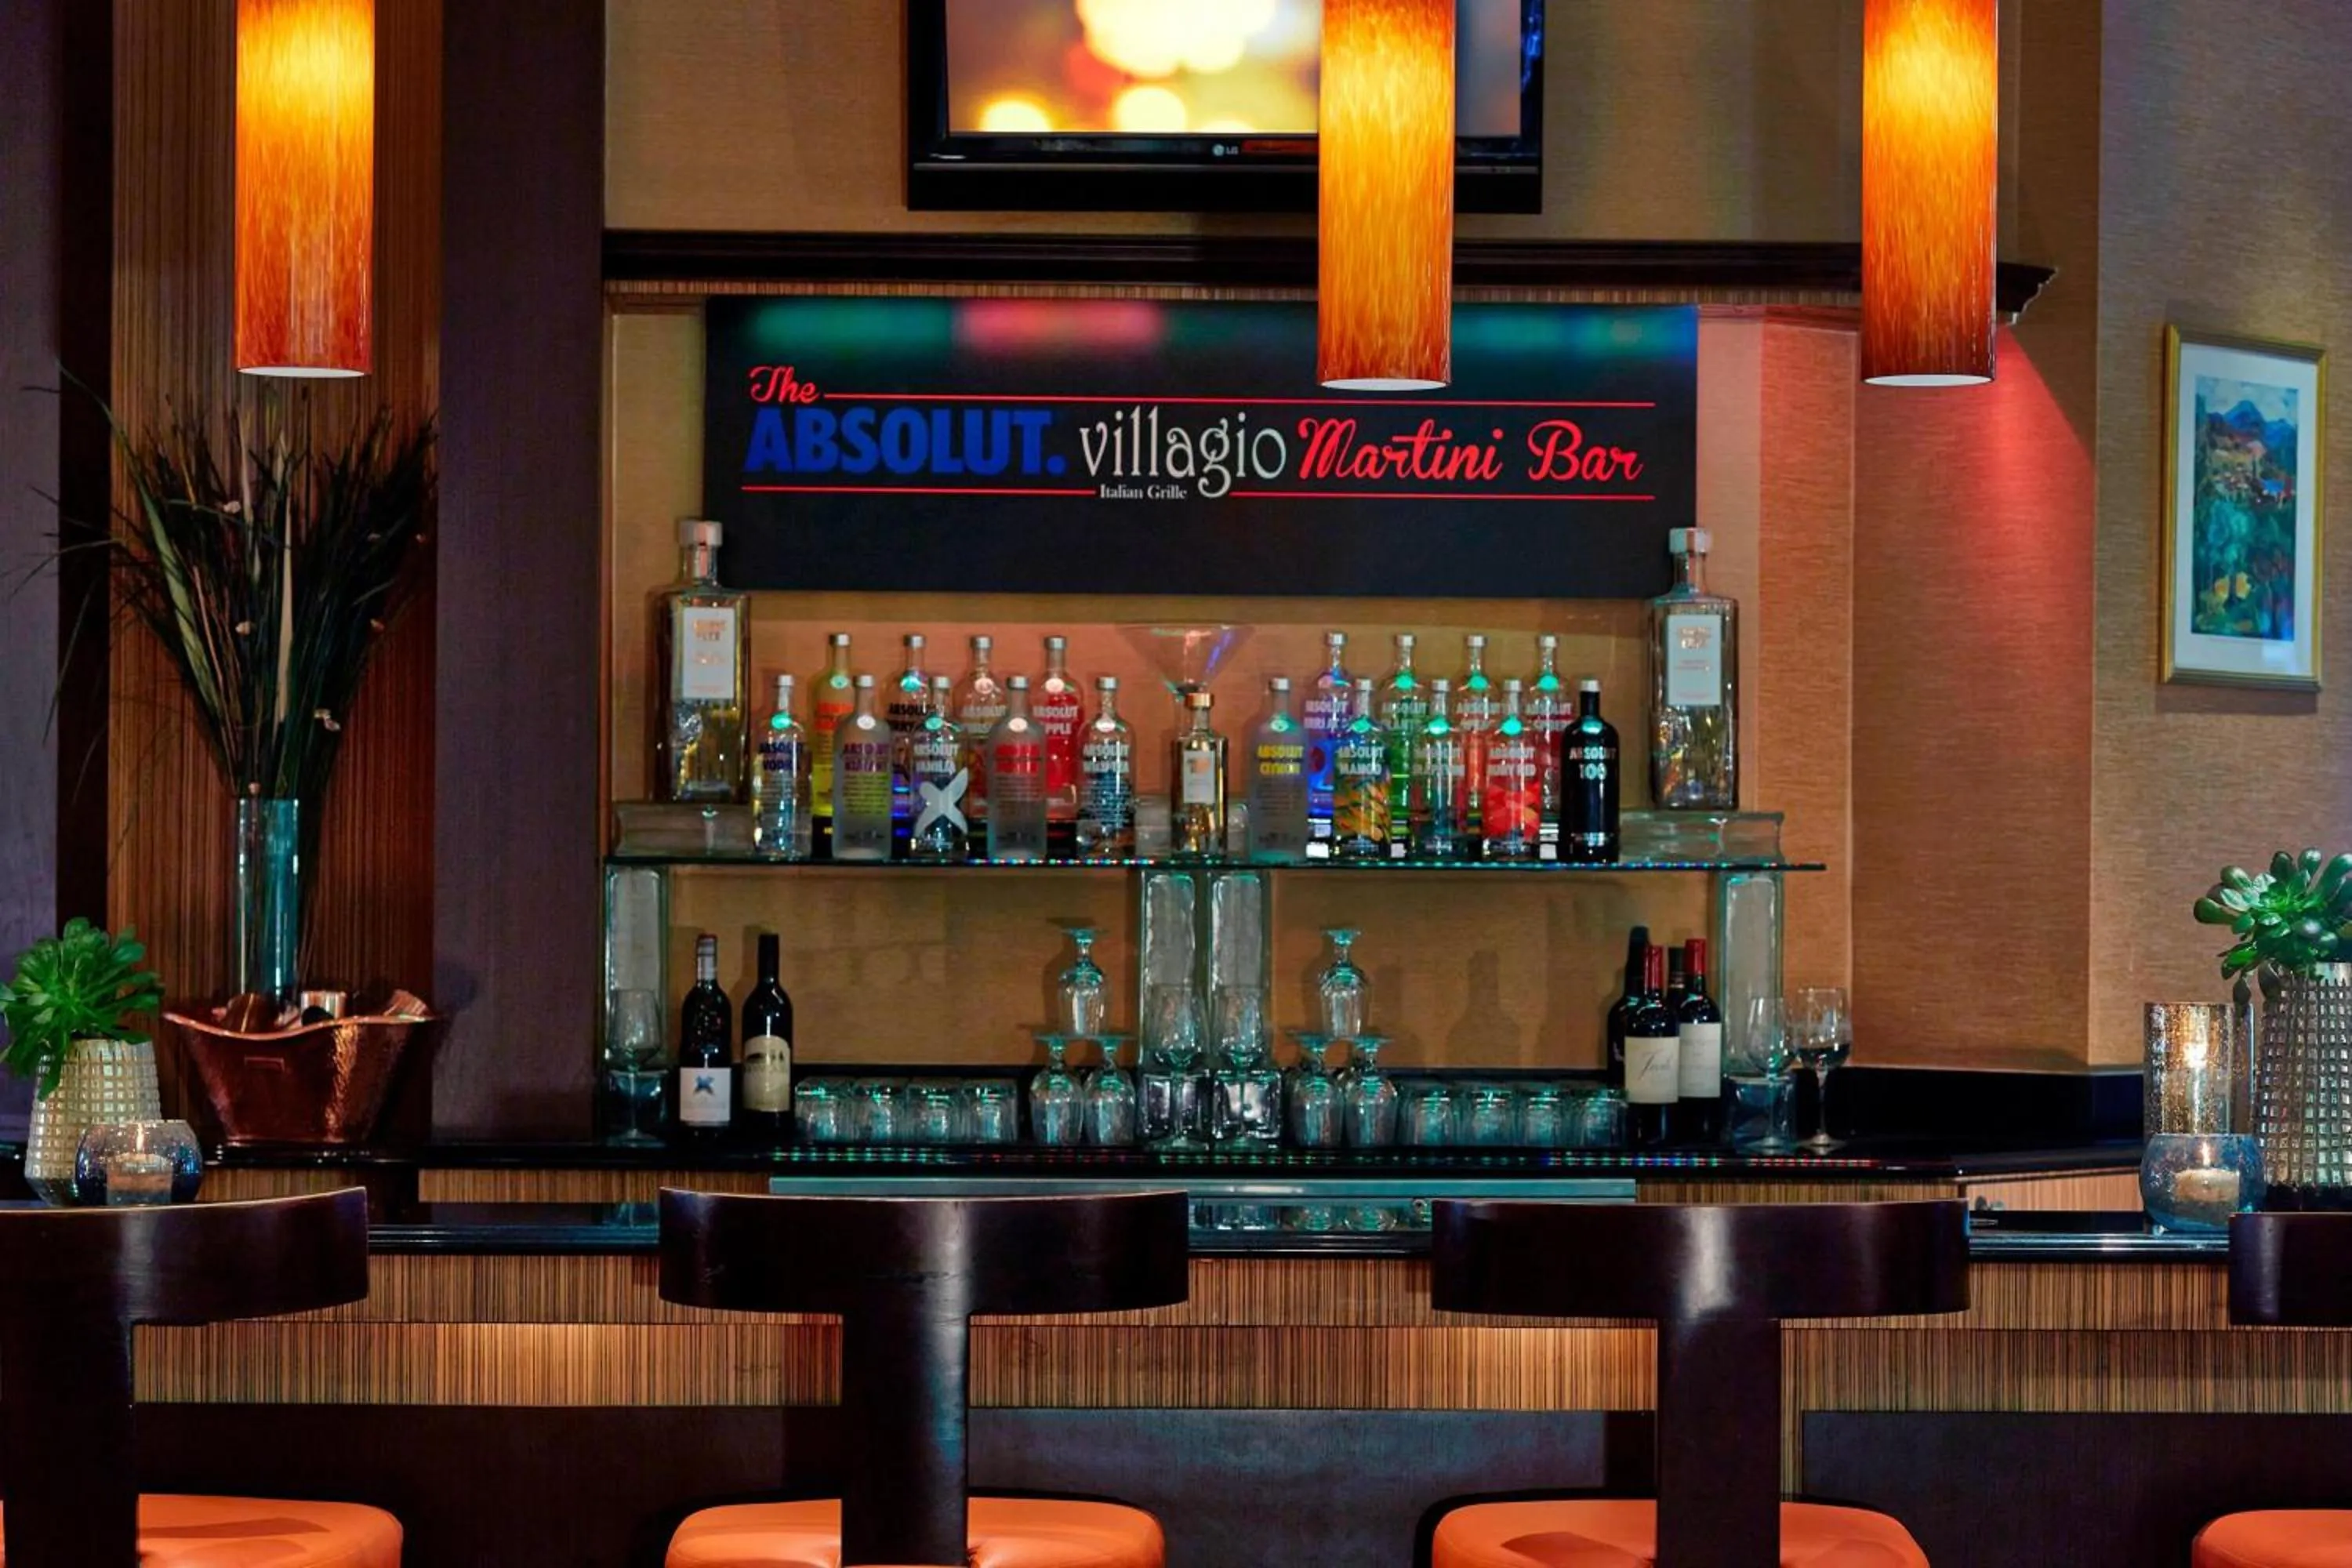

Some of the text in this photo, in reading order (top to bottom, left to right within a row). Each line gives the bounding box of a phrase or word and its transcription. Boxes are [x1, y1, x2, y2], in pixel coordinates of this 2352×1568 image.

[750, 366, 820, 403] The
[743, 405, 1643, 498] ABSOLUT. villagio Martini Bar
[1100, 484, 1188, 499] Italian Grille
[1033, 705, 1079, 718] ABSOLUT
[1258, 745, 1304, 758] ABSOLUT
[1569, 747, 1616, 760] ABSOLUT
[1579, 762, 1607, 781] 100
